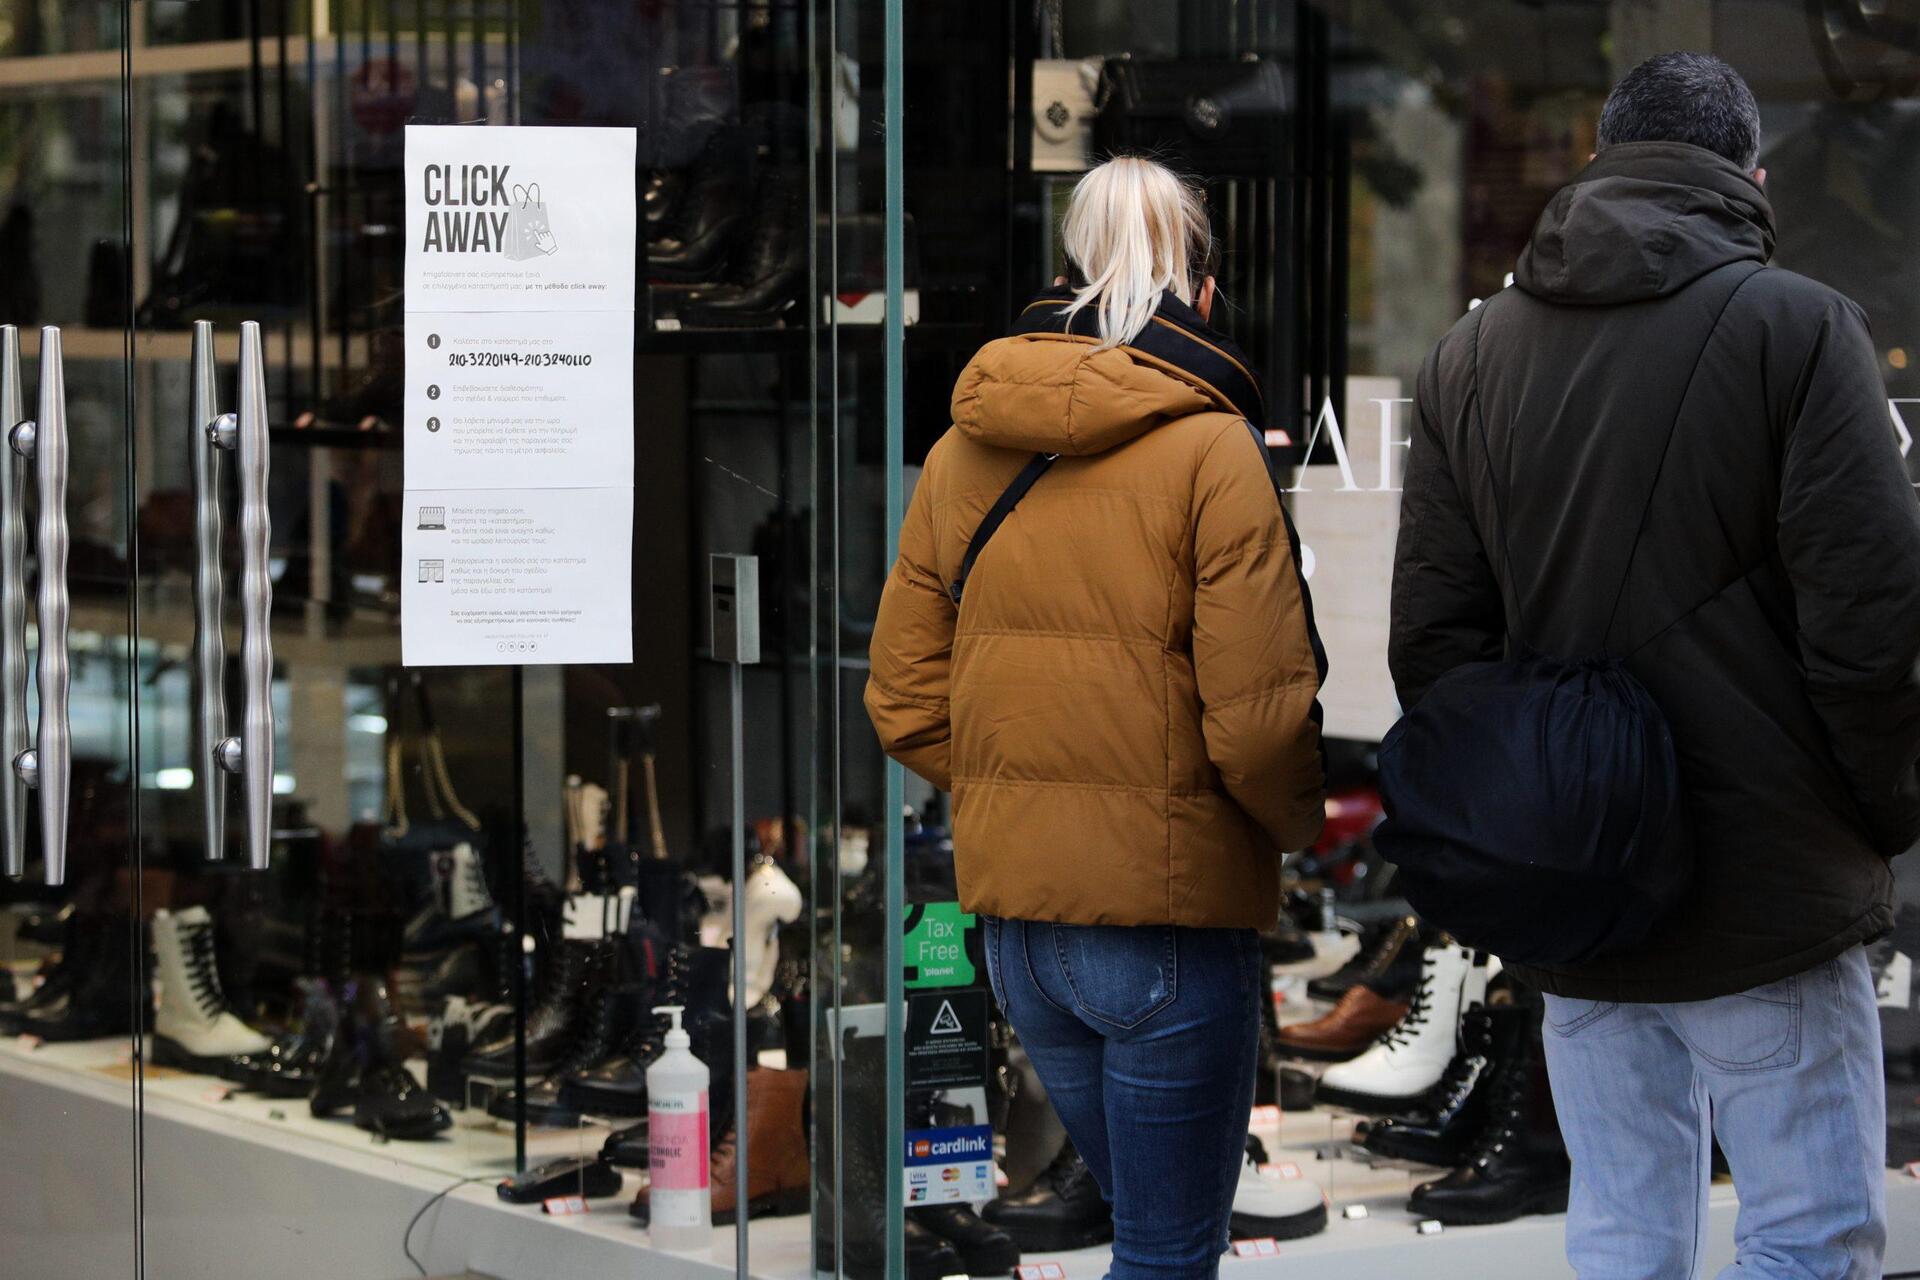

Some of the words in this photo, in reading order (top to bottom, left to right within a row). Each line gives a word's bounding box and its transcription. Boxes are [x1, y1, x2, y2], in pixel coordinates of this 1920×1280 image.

[424, 164, 511, 207] CLICK
[423, 211, 509, 253] AWAY
[525, 281, 534, 290] με
[534, 281, 543, 290] τη
[544, 281, 568, 290] μέθοδο
[570, 281, 586, 290] click
[924, 918, 954, 938] Tax
[919, 941, 959, 961] Free
[931, 1136, 986, 1157] cardlink
